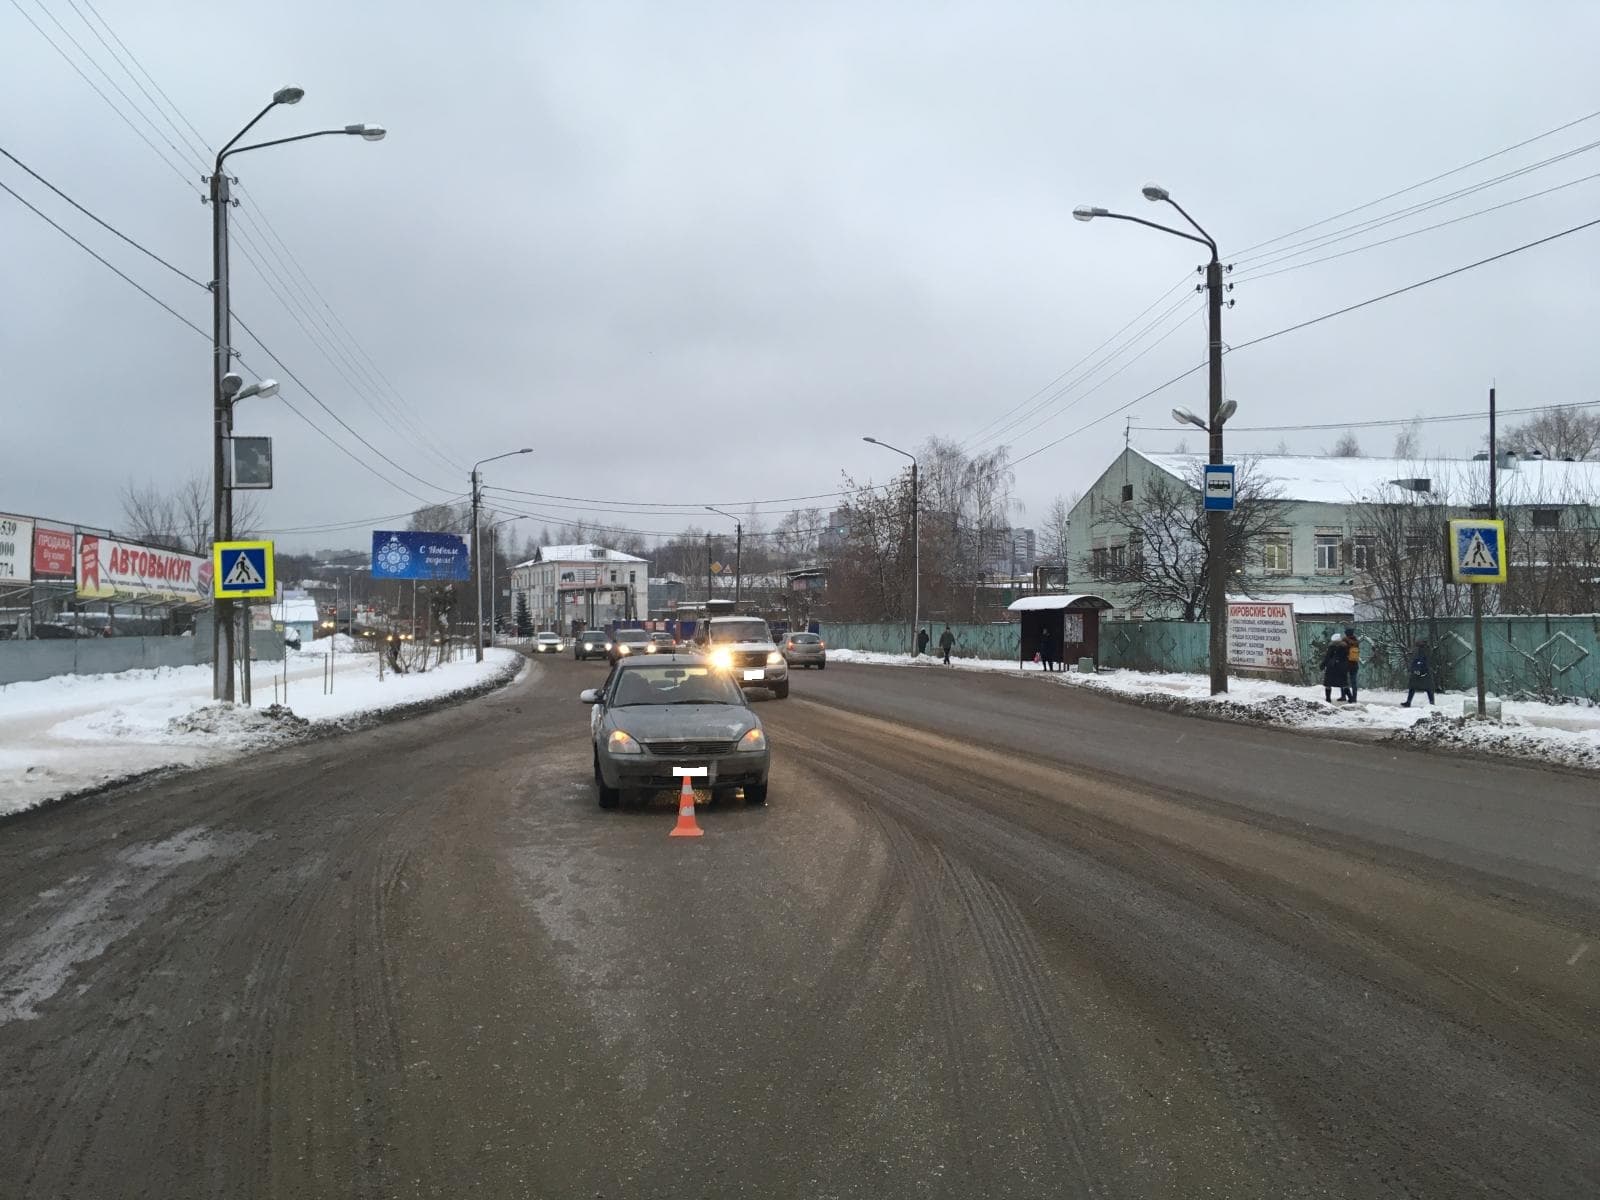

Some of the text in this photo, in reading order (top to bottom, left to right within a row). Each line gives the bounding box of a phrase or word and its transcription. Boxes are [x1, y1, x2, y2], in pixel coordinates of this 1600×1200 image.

[38, 534, 71, 551] ПРОДАЖА
[419, 545, 426, 554] С
[110, 547, 192, 582] АВТОВЫКУП
[1230, 606, 1287, 617] КИРОВСКИЕ ОКНА
